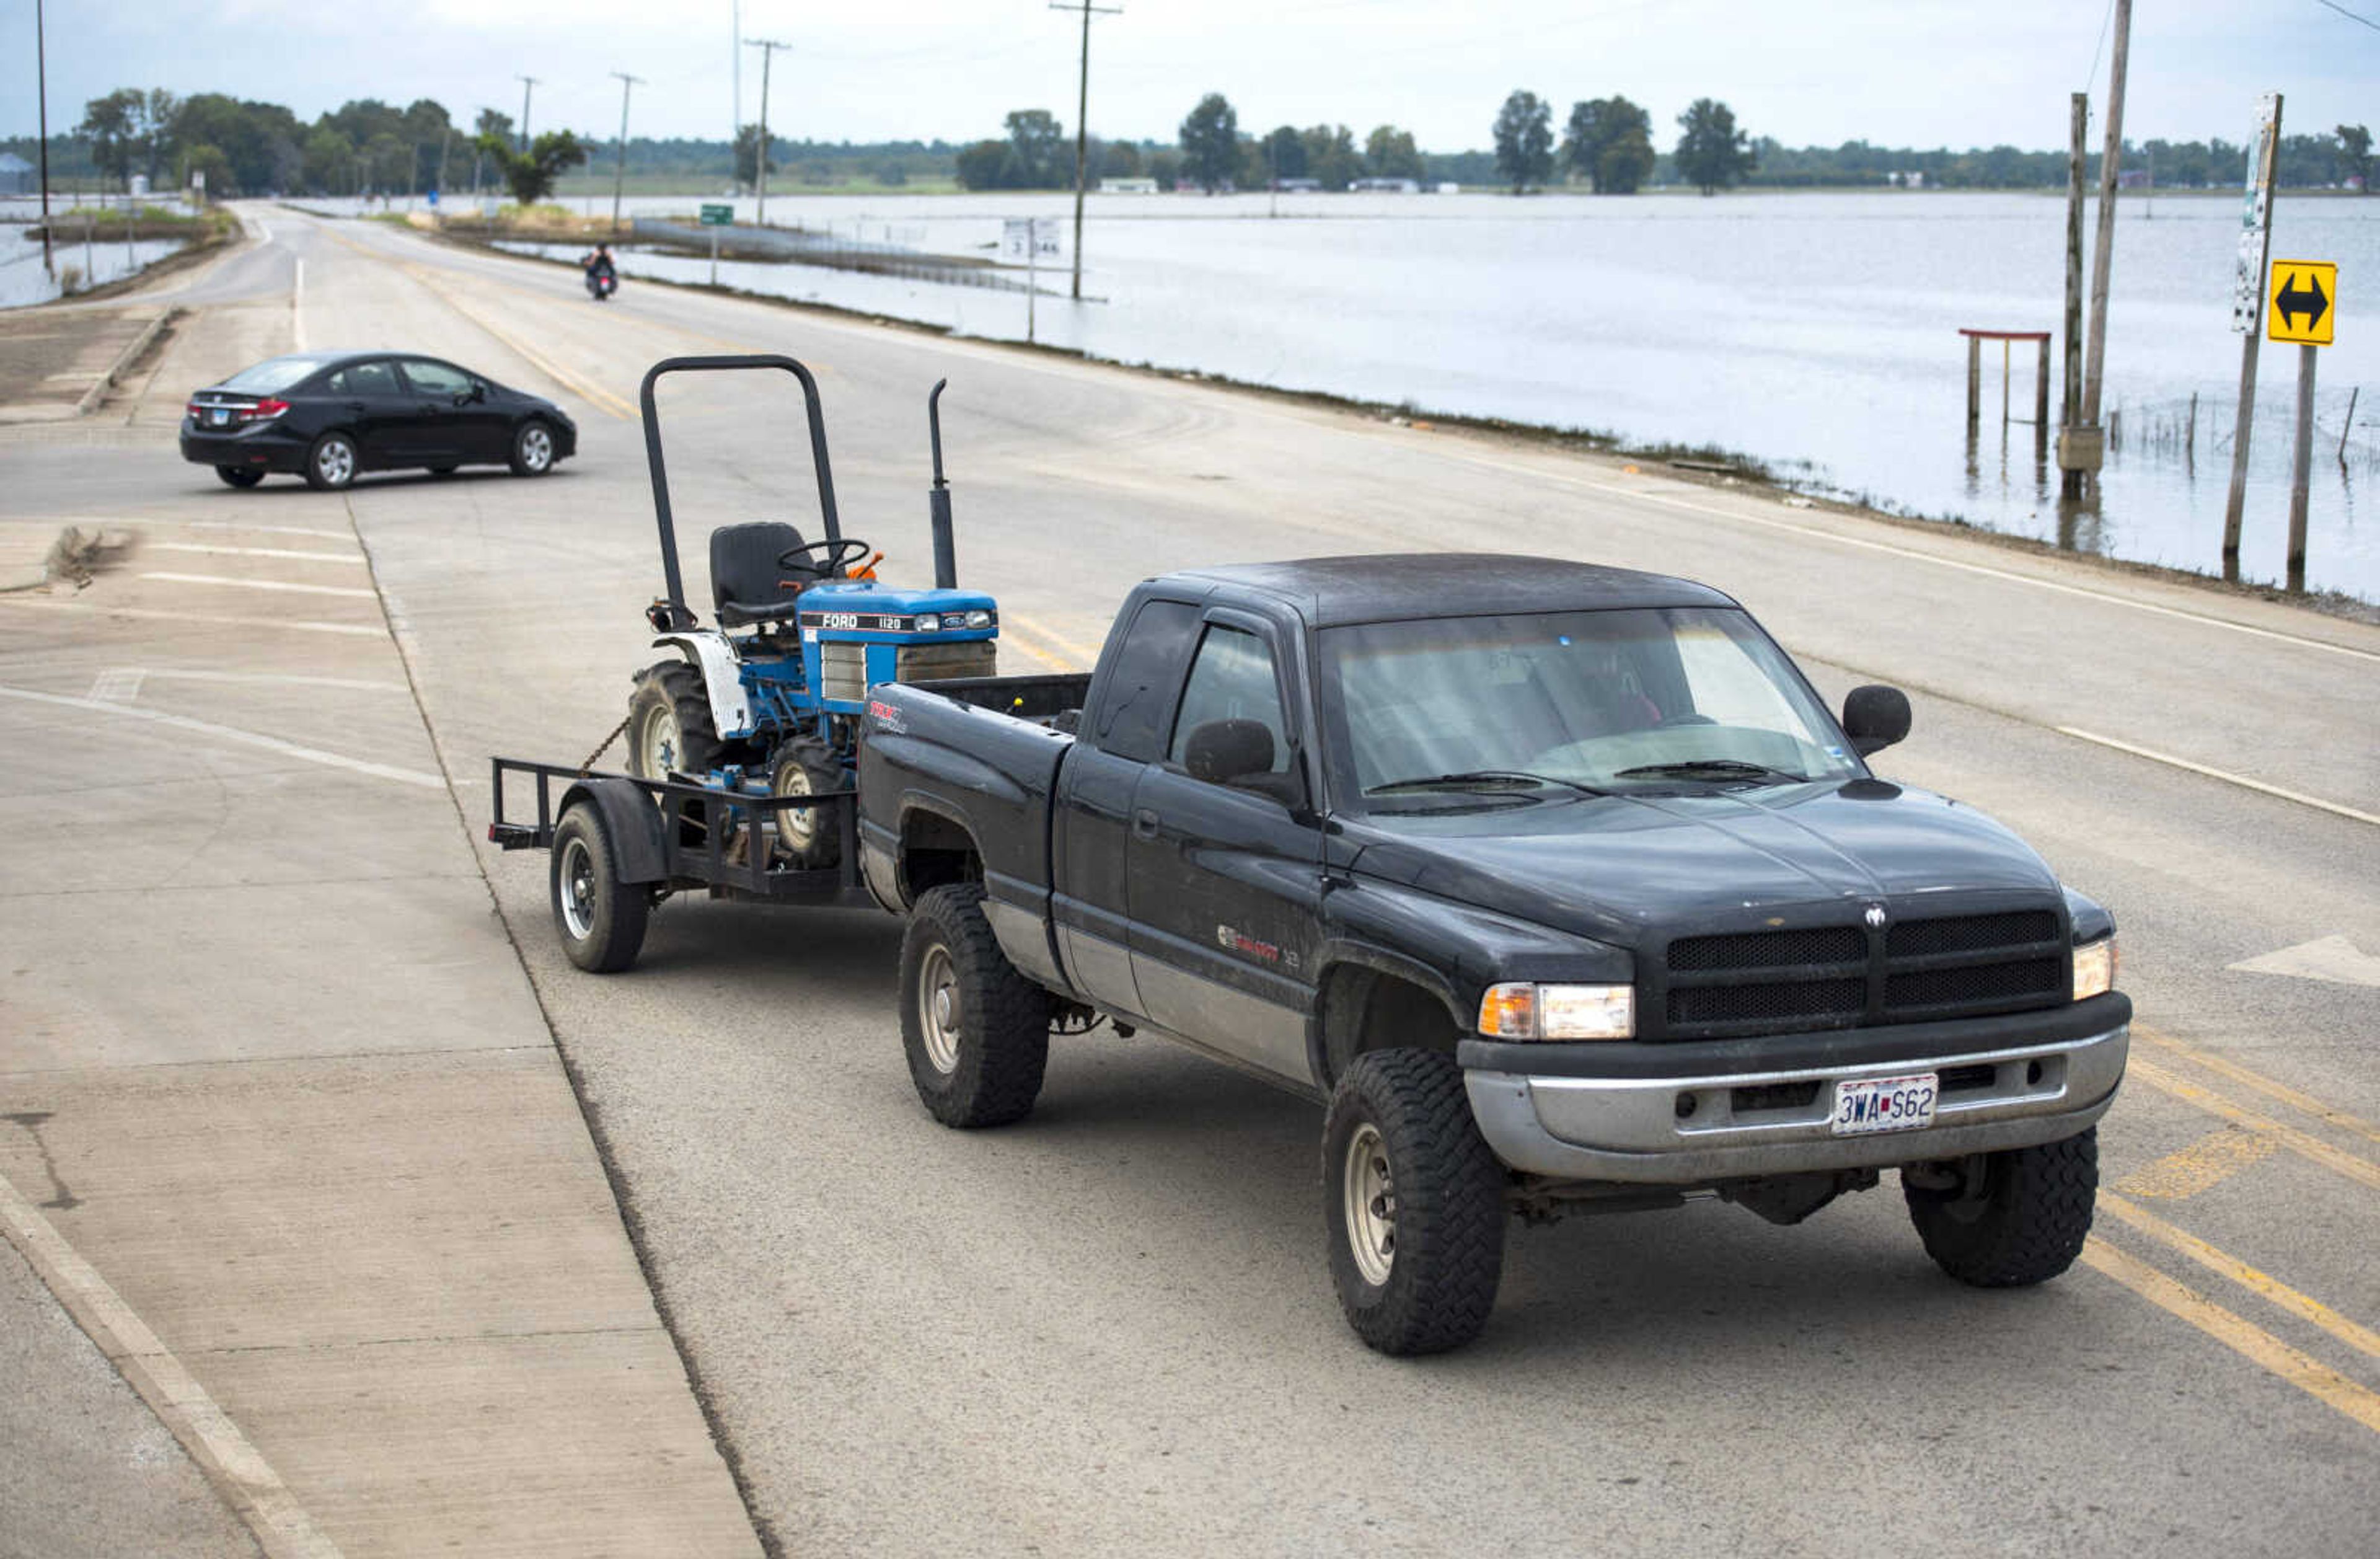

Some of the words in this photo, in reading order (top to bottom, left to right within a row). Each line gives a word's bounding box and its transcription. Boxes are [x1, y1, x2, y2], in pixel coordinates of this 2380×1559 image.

[822, 614, 858, 629] FORD
[879, 616, 901, 629] 1120
[1838, 1092, 1879, 1124] 3WA
[1891, 1087, 1933, 1119] S62
